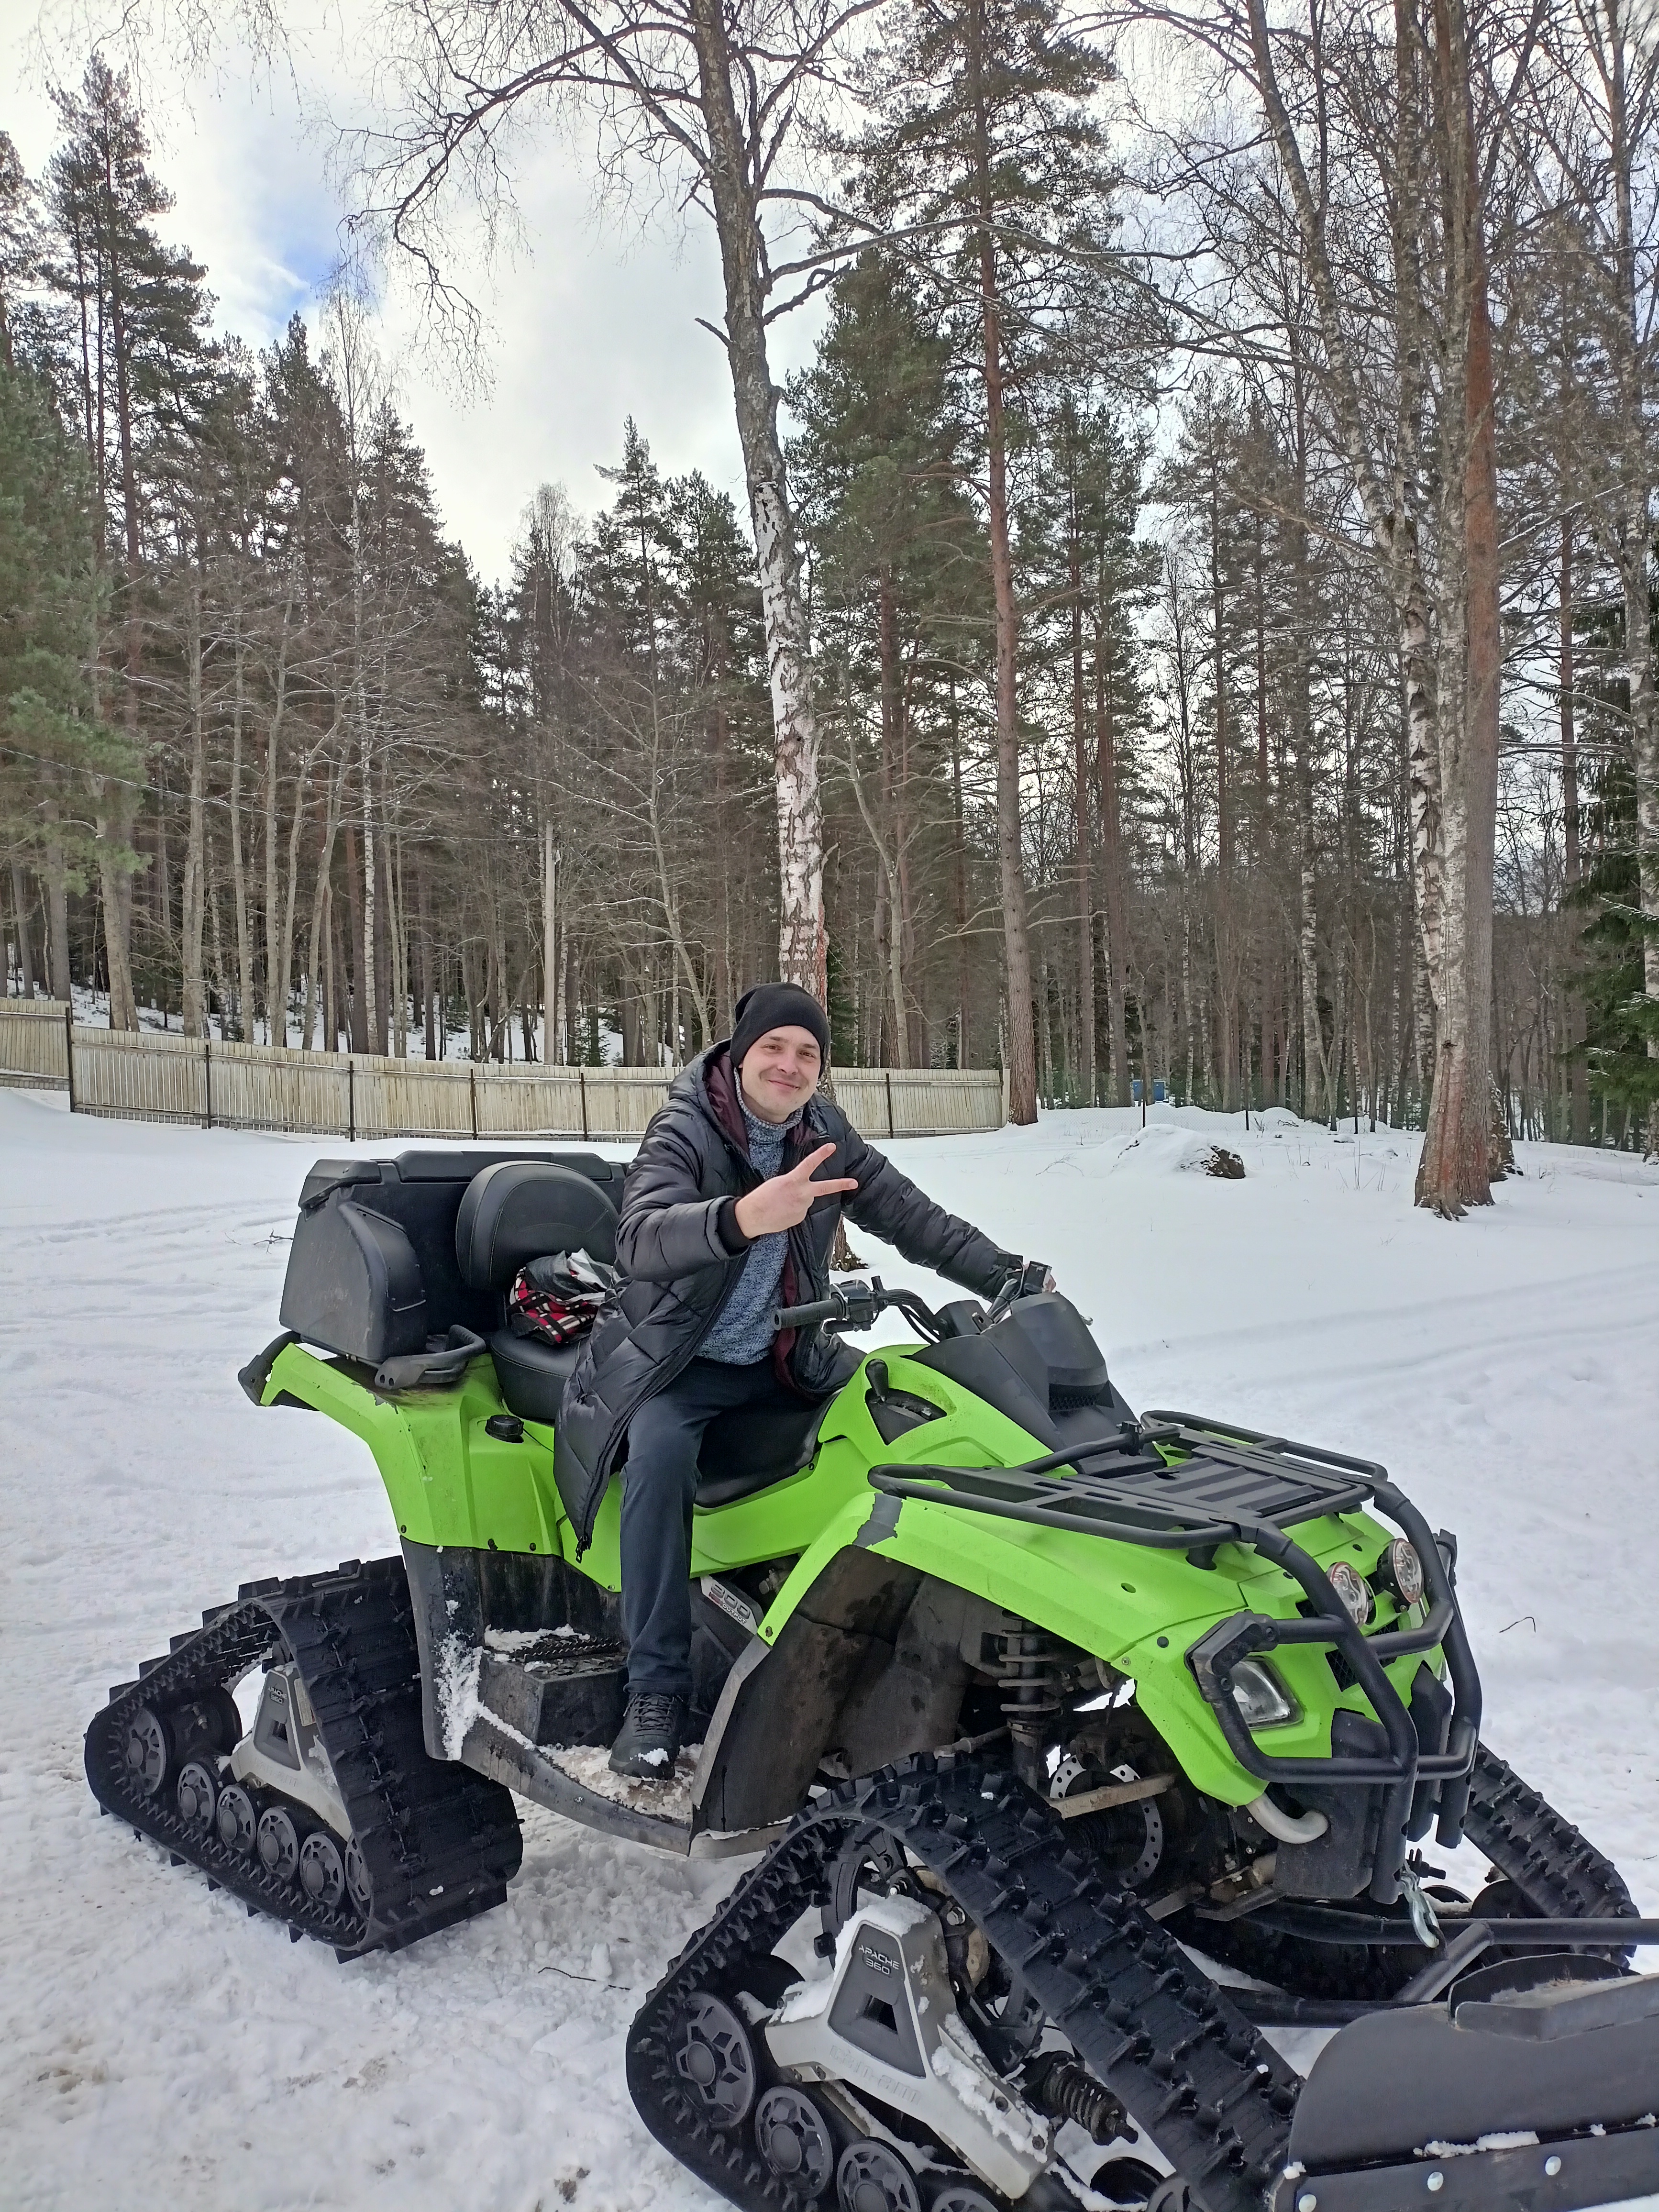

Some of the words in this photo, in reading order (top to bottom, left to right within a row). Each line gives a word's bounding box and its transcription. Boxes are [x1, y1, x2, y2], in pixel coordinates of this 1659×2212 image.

[722, 1603, 747, 1624] OUTPUT
[858, 1945, 900, 1970] APACHE
[865, 1959, 891, 1975] 360
